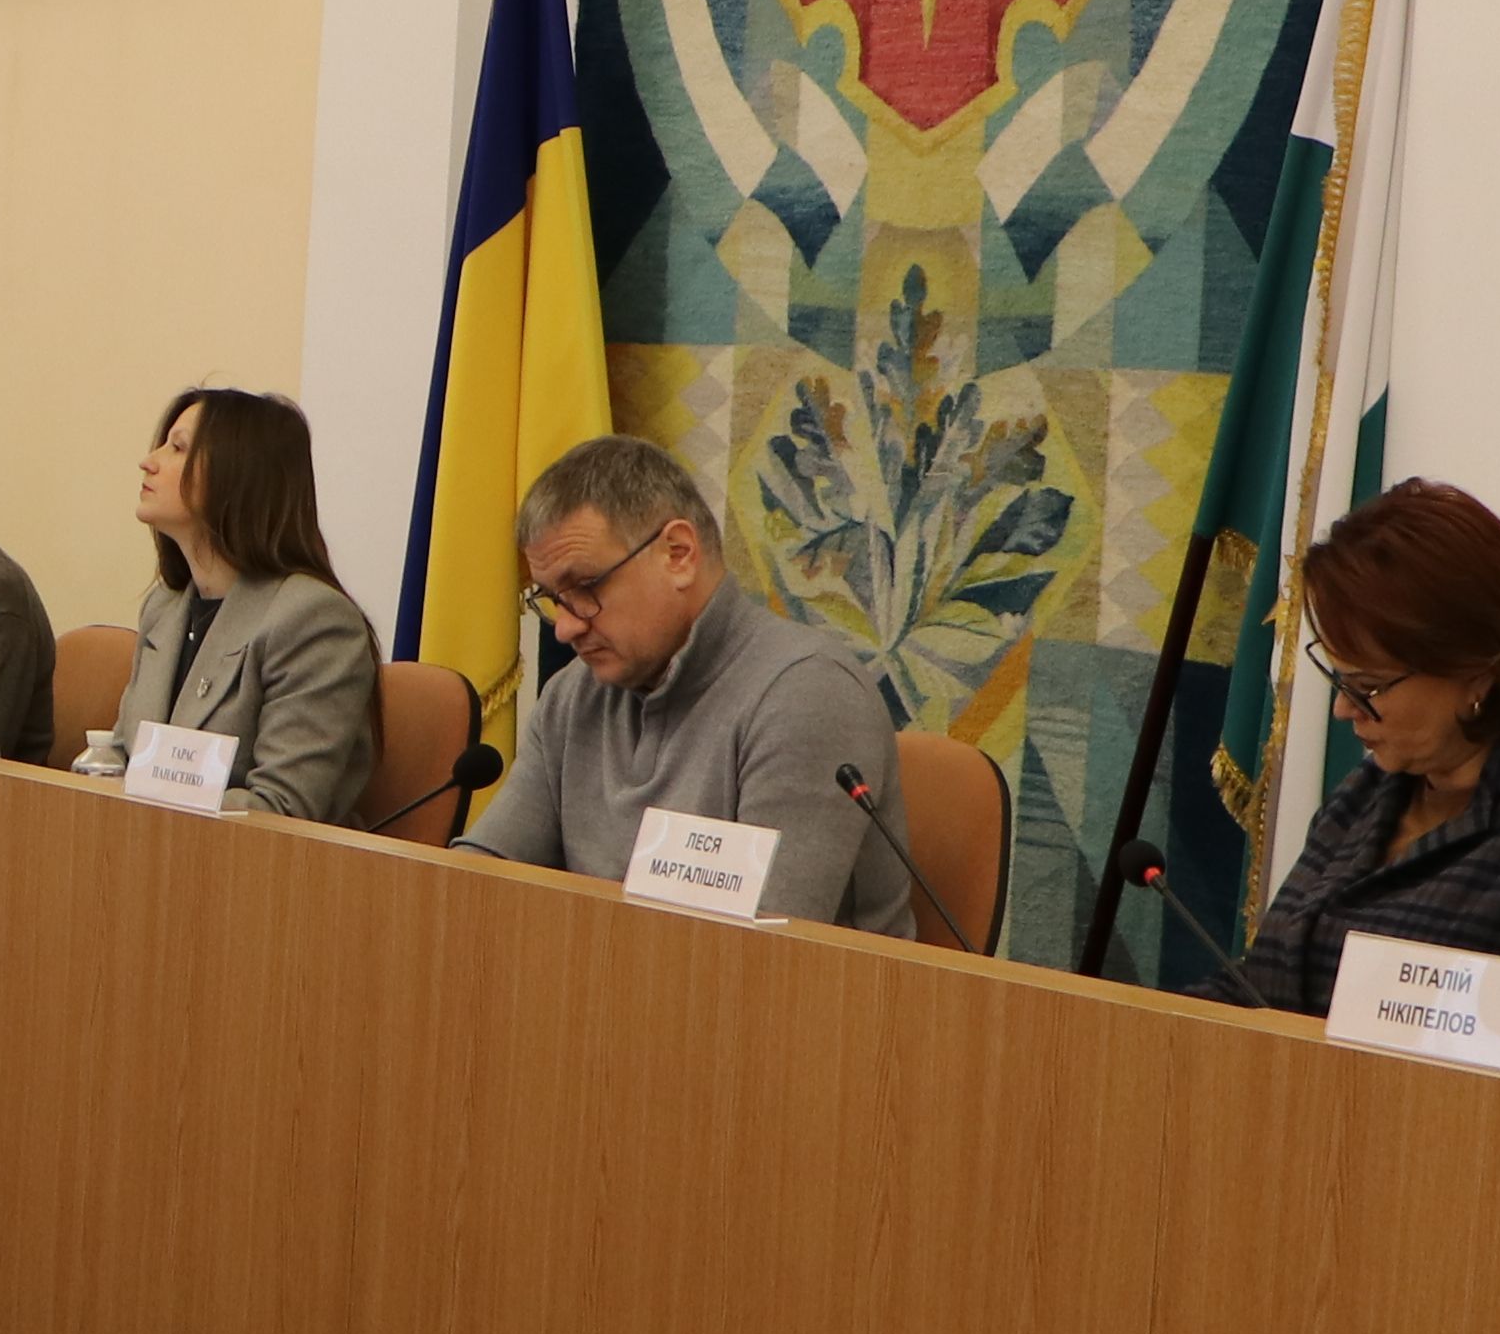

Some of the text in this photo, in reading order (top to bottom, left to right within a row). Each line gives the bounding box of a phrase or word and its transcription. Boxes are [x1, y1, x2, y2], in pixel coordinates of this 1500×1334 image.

[171, 746, 198, 763] ТАРАС
[684, 831, 723, 855] ЛЕСЯ
[649, 857, 744, 893] МАРТАЛІШВІЛІ
[1398, 962, 1473, 994] ВІТАЛІЙ
[1377, 999, 1477, 1036] НІКІПЕЛОВ
